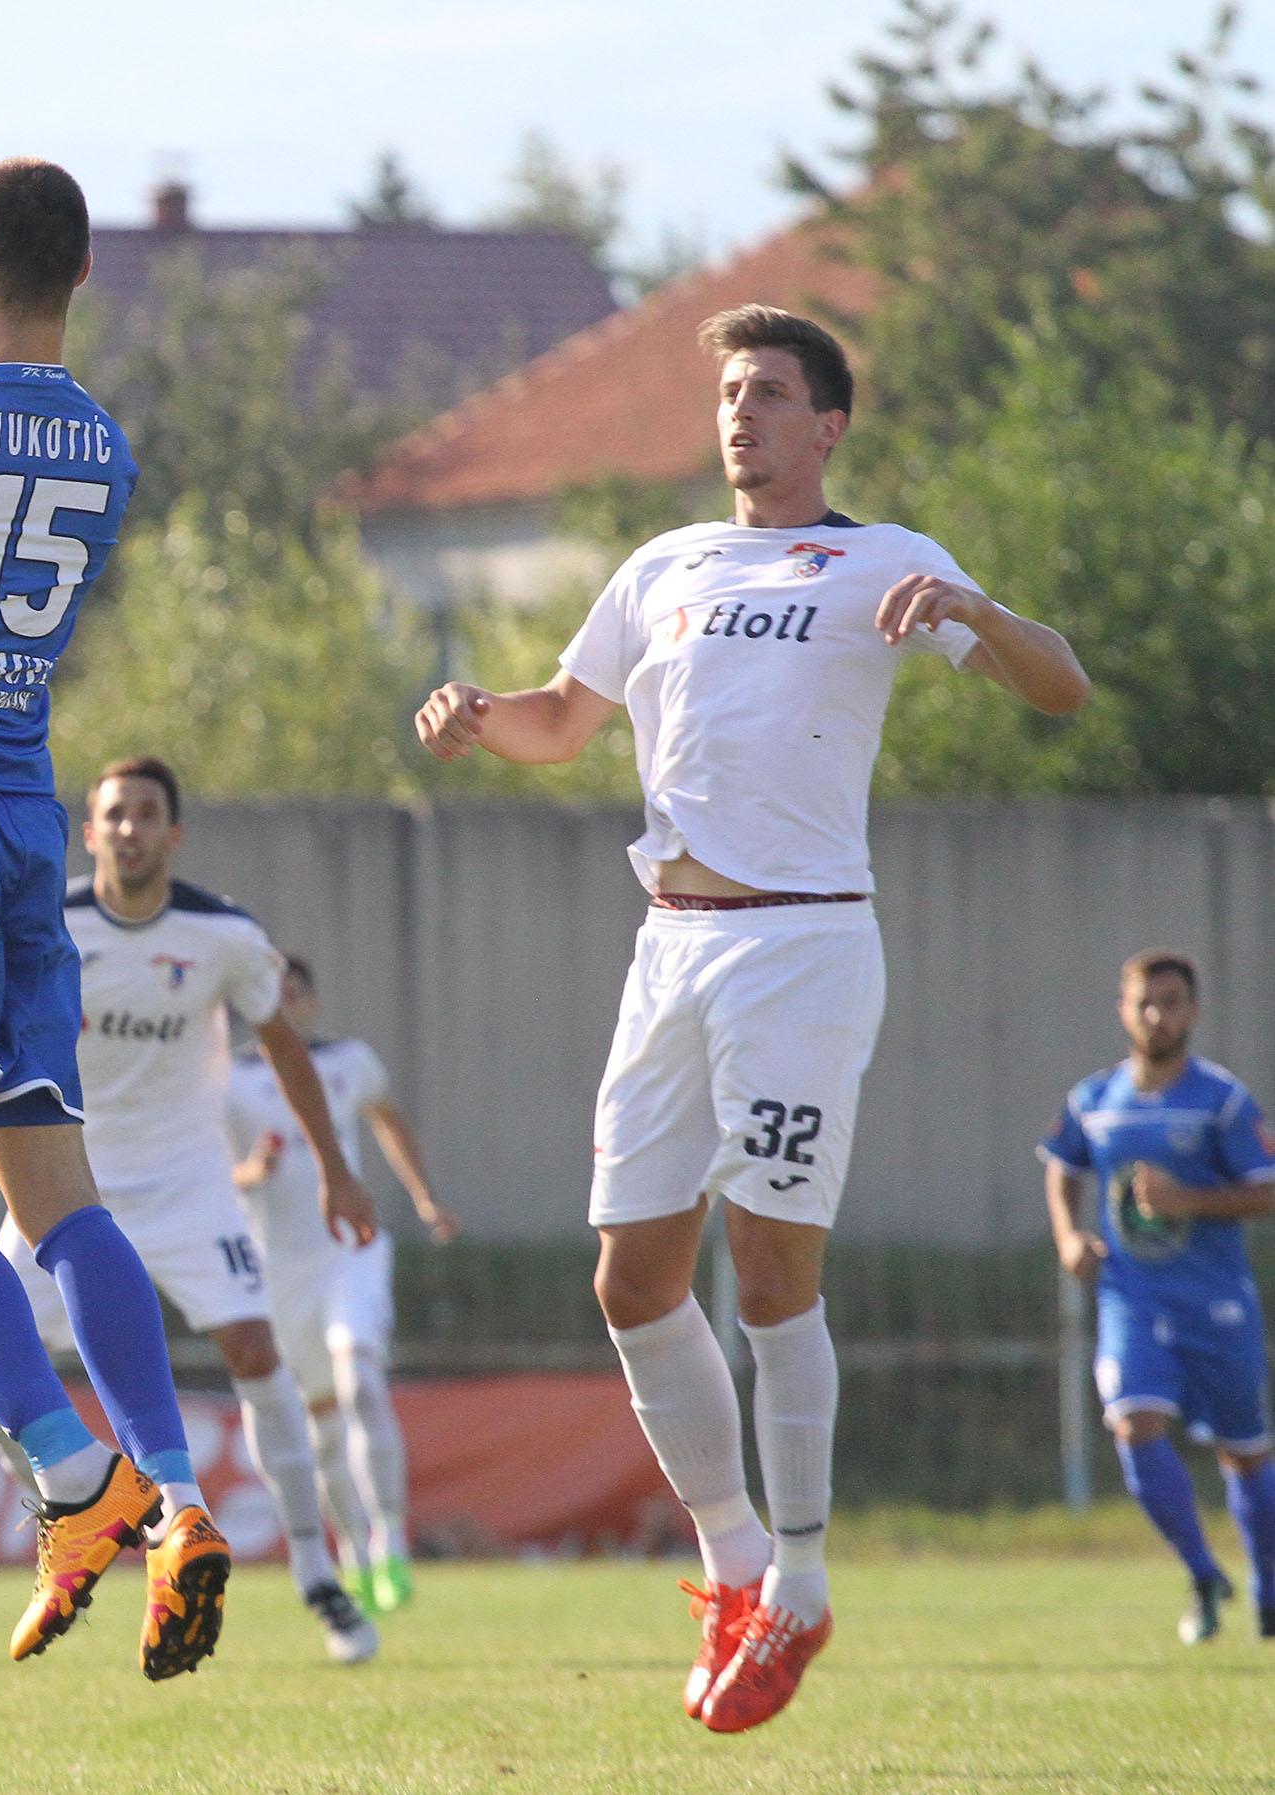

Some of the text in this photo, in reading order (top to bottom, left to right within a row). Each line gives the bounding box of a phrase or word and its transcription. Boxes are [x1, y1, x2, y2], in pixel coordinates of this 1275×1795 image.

[701, 602, 818, 642] tioil
[99, 1010, 187, 1042] tioil
[744, 1098, 822, 1166] 32
